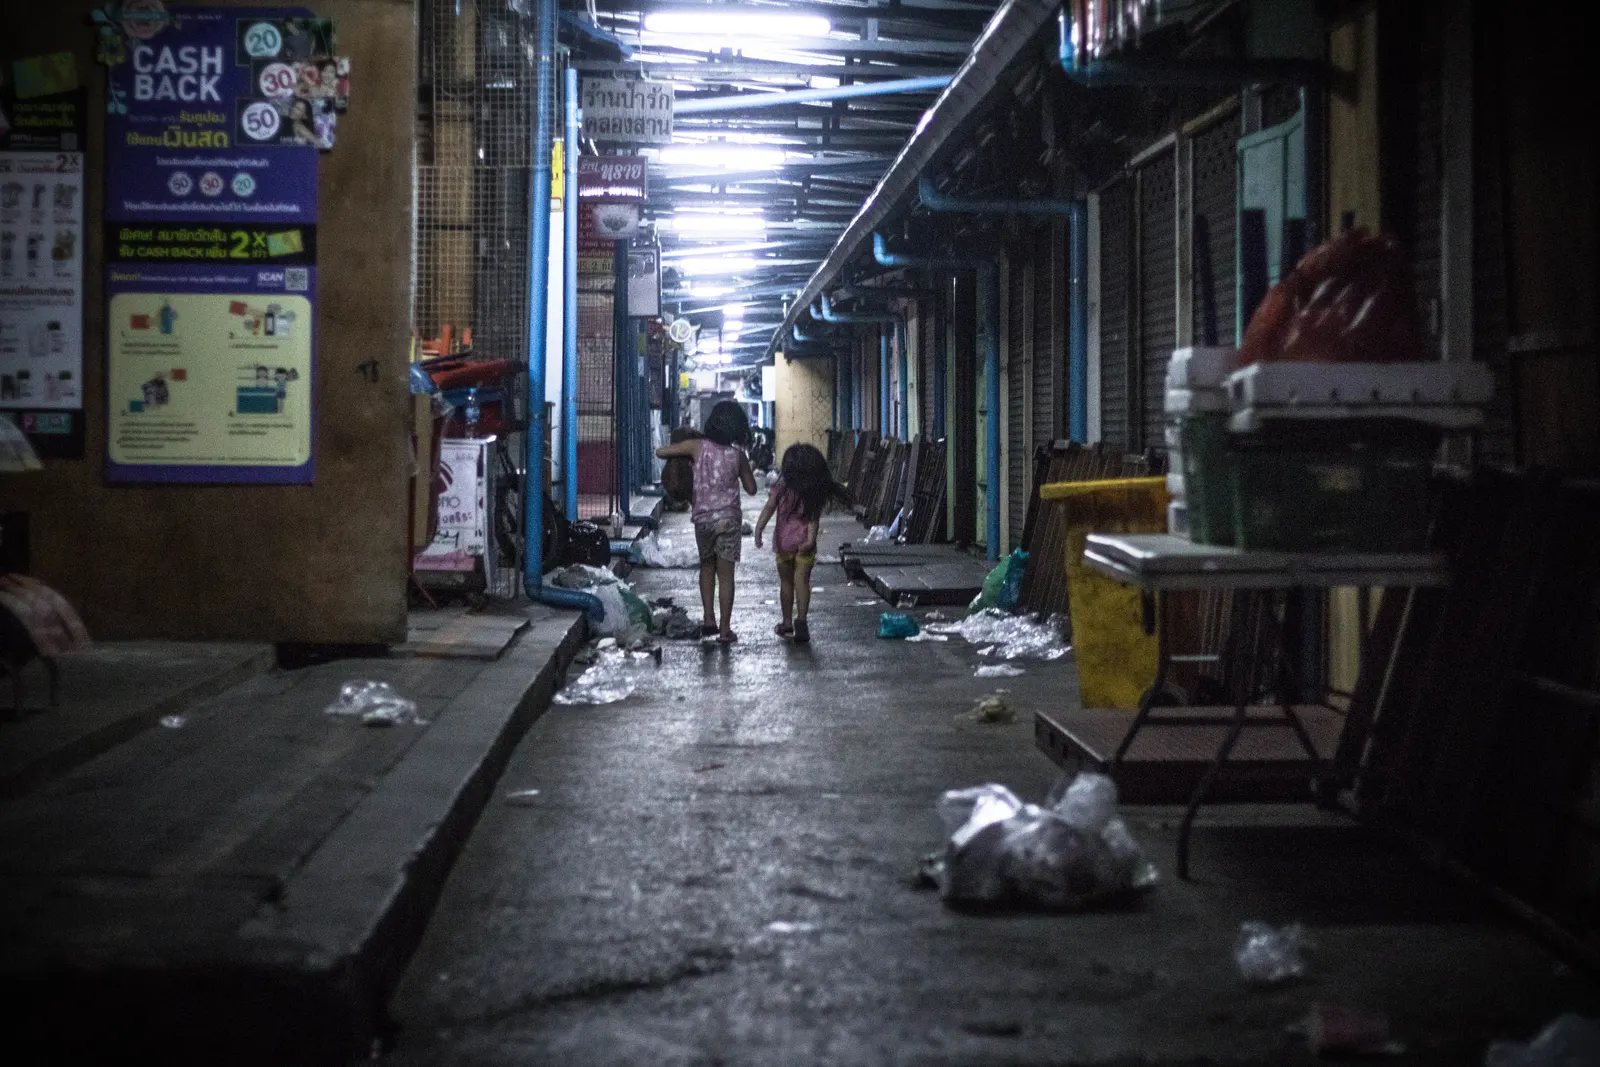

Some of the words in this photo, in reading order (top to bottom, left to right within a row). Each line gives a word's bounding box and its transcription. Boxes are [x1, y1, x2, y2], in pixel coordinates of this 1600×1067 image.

[249, 28, 278, 52] 20
[134, 46, 223, 74] CASH
[134, 75, 221, 101] BACK
[264, 69, 294, 91] 30
[585, 81, 670, 111] ร้านป้ารัก
[247, 108, 276, 133] 50
[584, 115, 670, 136] คลองสาน
[137, 246, 169, 257] CASH
[171, 246, 204, 257] BACK
[257, 272, 284, 282] SCAN
